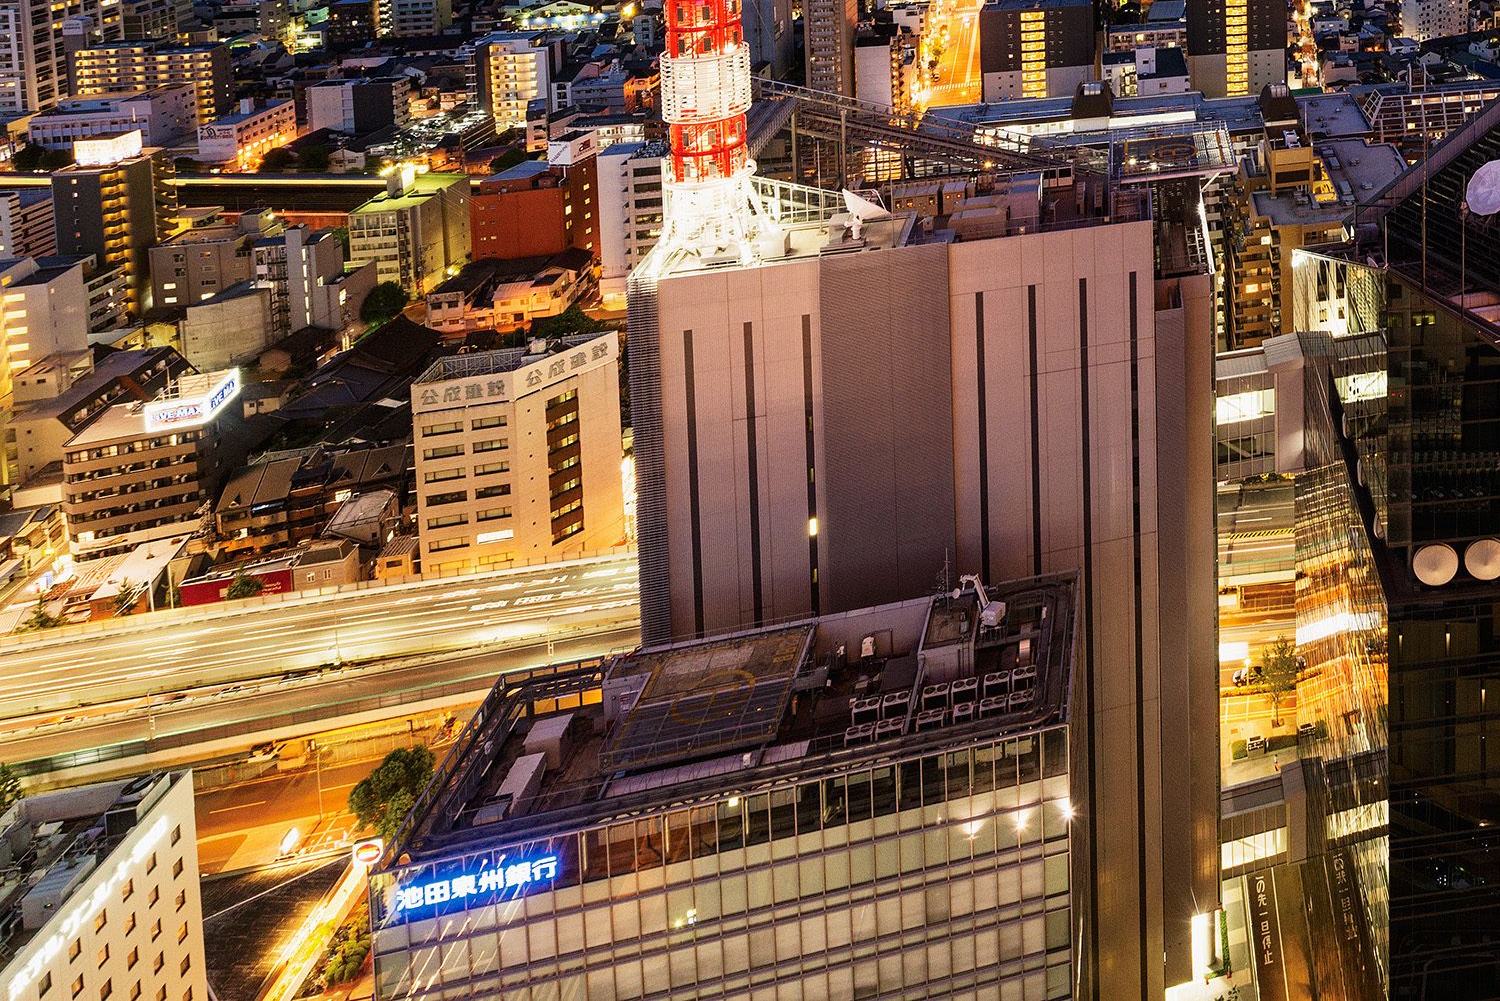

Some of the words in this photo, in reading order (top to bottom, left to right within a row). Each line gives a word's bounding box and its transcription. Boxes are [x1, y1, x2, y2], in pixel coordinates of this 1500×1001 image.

[524, 341, 610, 388] 公成建設
[421, 379, 506, 406] 公成建設
[395, 855, 558, 911] 池田泉州銀行
